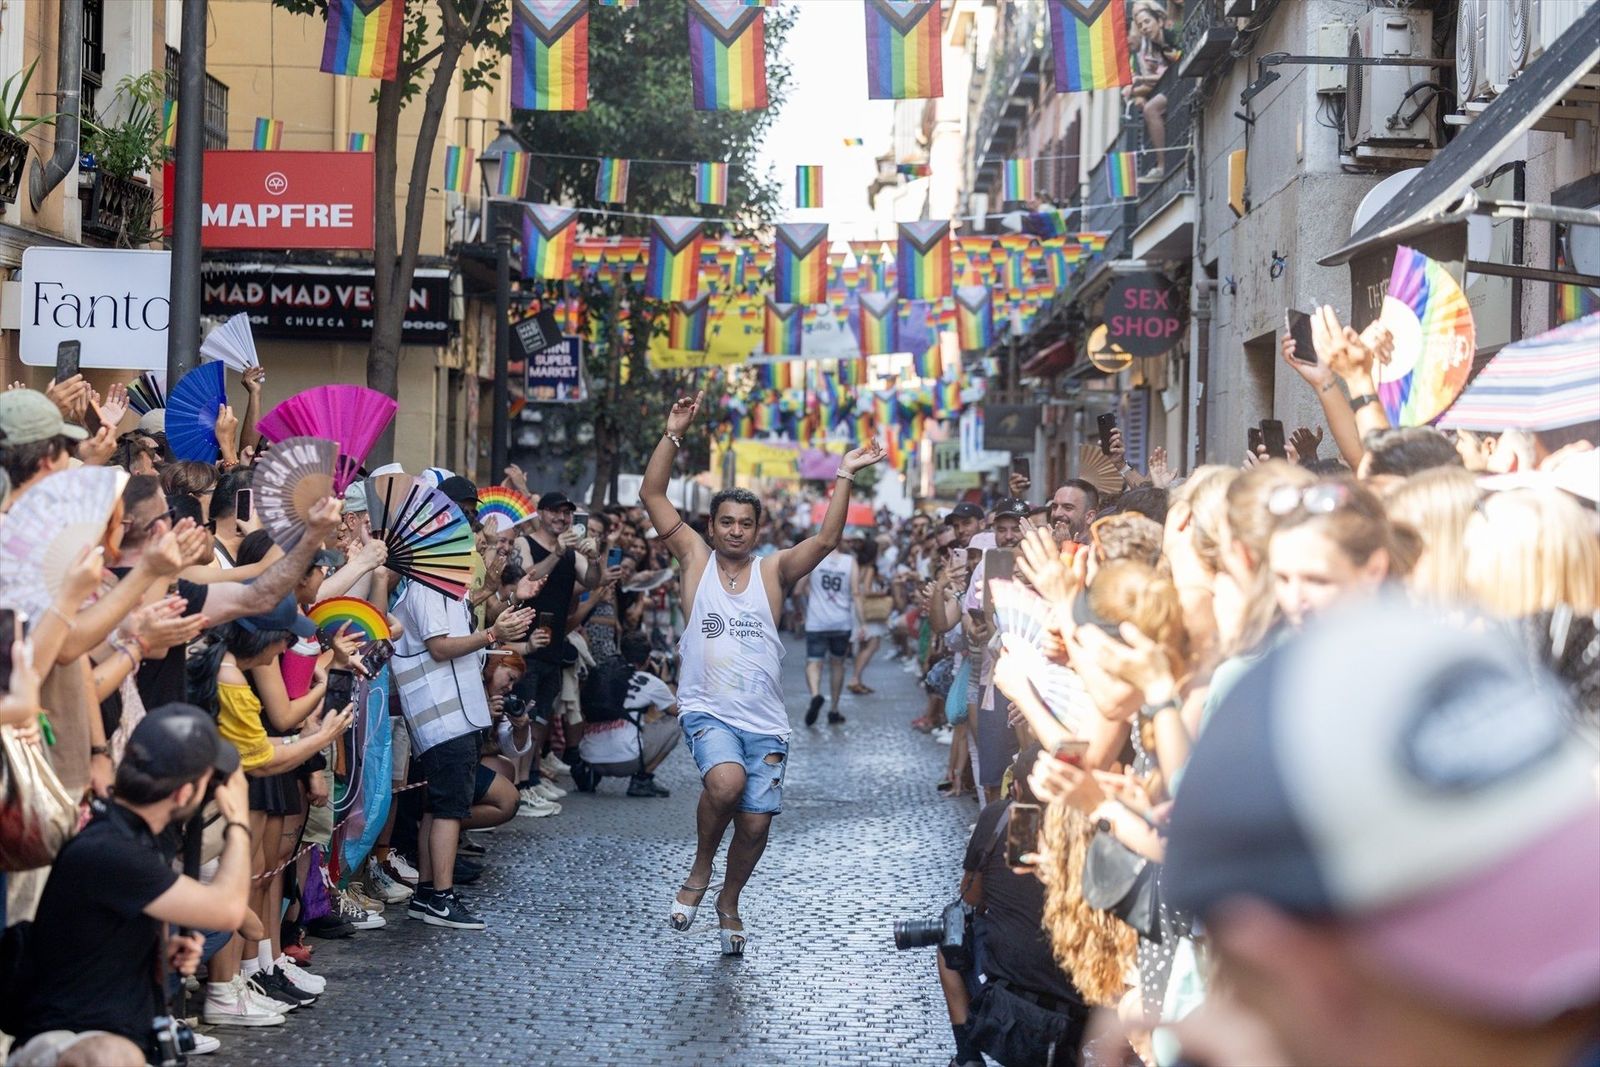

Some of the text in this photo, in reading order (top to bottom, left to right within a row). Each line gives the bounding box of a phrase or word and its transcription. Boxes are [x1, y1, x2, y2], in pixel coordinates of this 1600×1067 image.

[202, 203, 353, 228] MAPFRE
[204, 282, 427, 309] MAD MAD VEN
[1124, 288, 1169, 311] SEX
[285, 316, 345, 328] CHUECA
[1111, 315, 1180, 338] SHOP
[543, 341, 570, 353] INI
[535, 354, 572, 365] SUPER
[528, 366, 577, 378] MARKET
